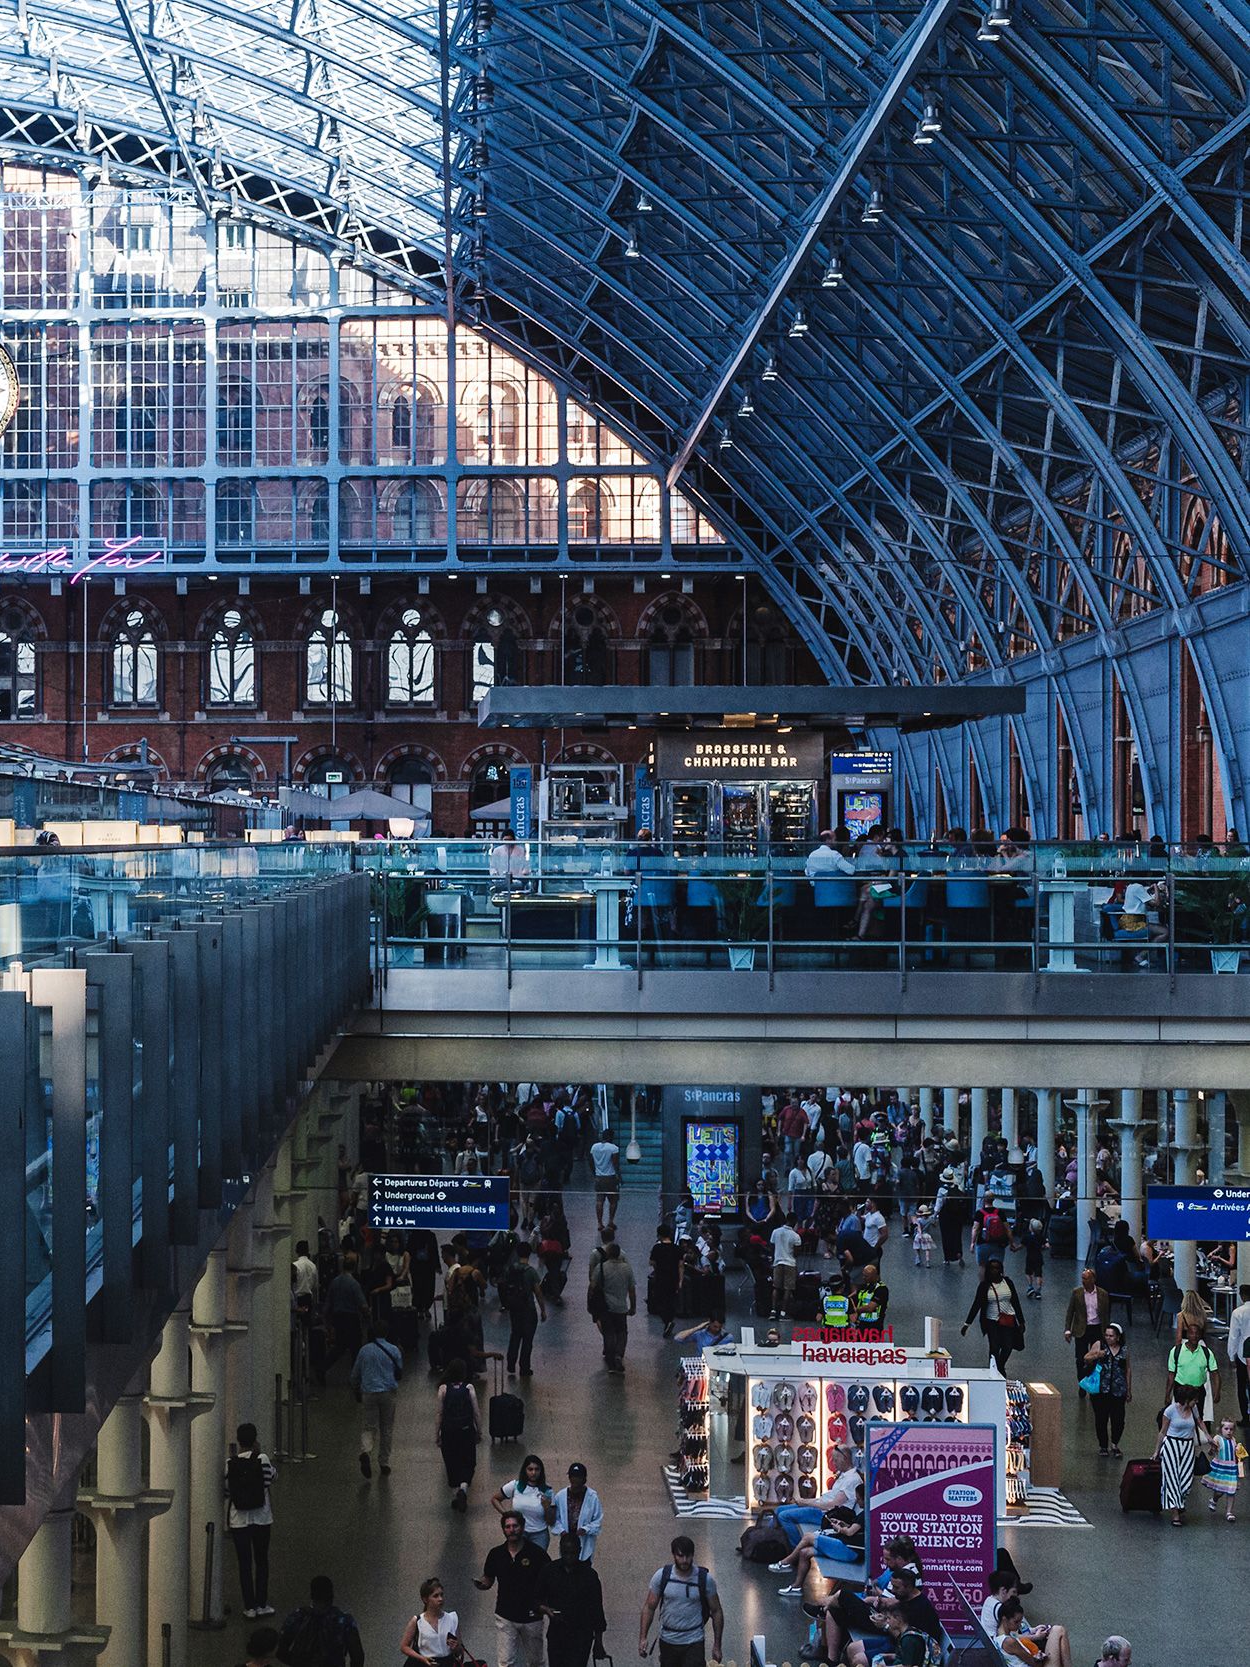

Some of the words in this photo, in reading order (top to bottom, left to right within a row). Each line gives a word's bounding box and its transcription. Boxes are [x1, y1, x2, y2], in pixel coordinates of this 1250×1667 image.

[695, 744, 772, 755] BRASSERIE
[777, 744, 787, 754] &
[684, 757, 766, 767] CHAMPAGNE
[771, 757, 798, 767] BAR
[516, 796, 525, 839] ancras
[641, 796, 650, 830] ncras
[384, 1178, 428, 1188] Departures
[429, 1178, 460, 1188] Départs
[384, 1191, 435, 1201] Underground
[384, 1204, 433, 1213] International
[434, 1204, 461, 1213] tickets
[462, 1205, 487, 1214] Billets
[1211, 1202, 1245, 1211] Arrivées
[802, 1343, 908, 1366] havaianas
[880, 1512, 903, 1521] HOW
[904, 1512, 938, 1521] WOULD
[940, 1513, 958, 1522] YOU
[960, 1514, 983, 1523] RATE
[880, 1521, 918, 1533] YOUR
[922, 1522, 983, 1535] STATION
[880, 1534, 983, 1549] EERIENCE?
[943, 1588, 983, 1603] £50
[935, 1603, 956, 1611] GIFT
